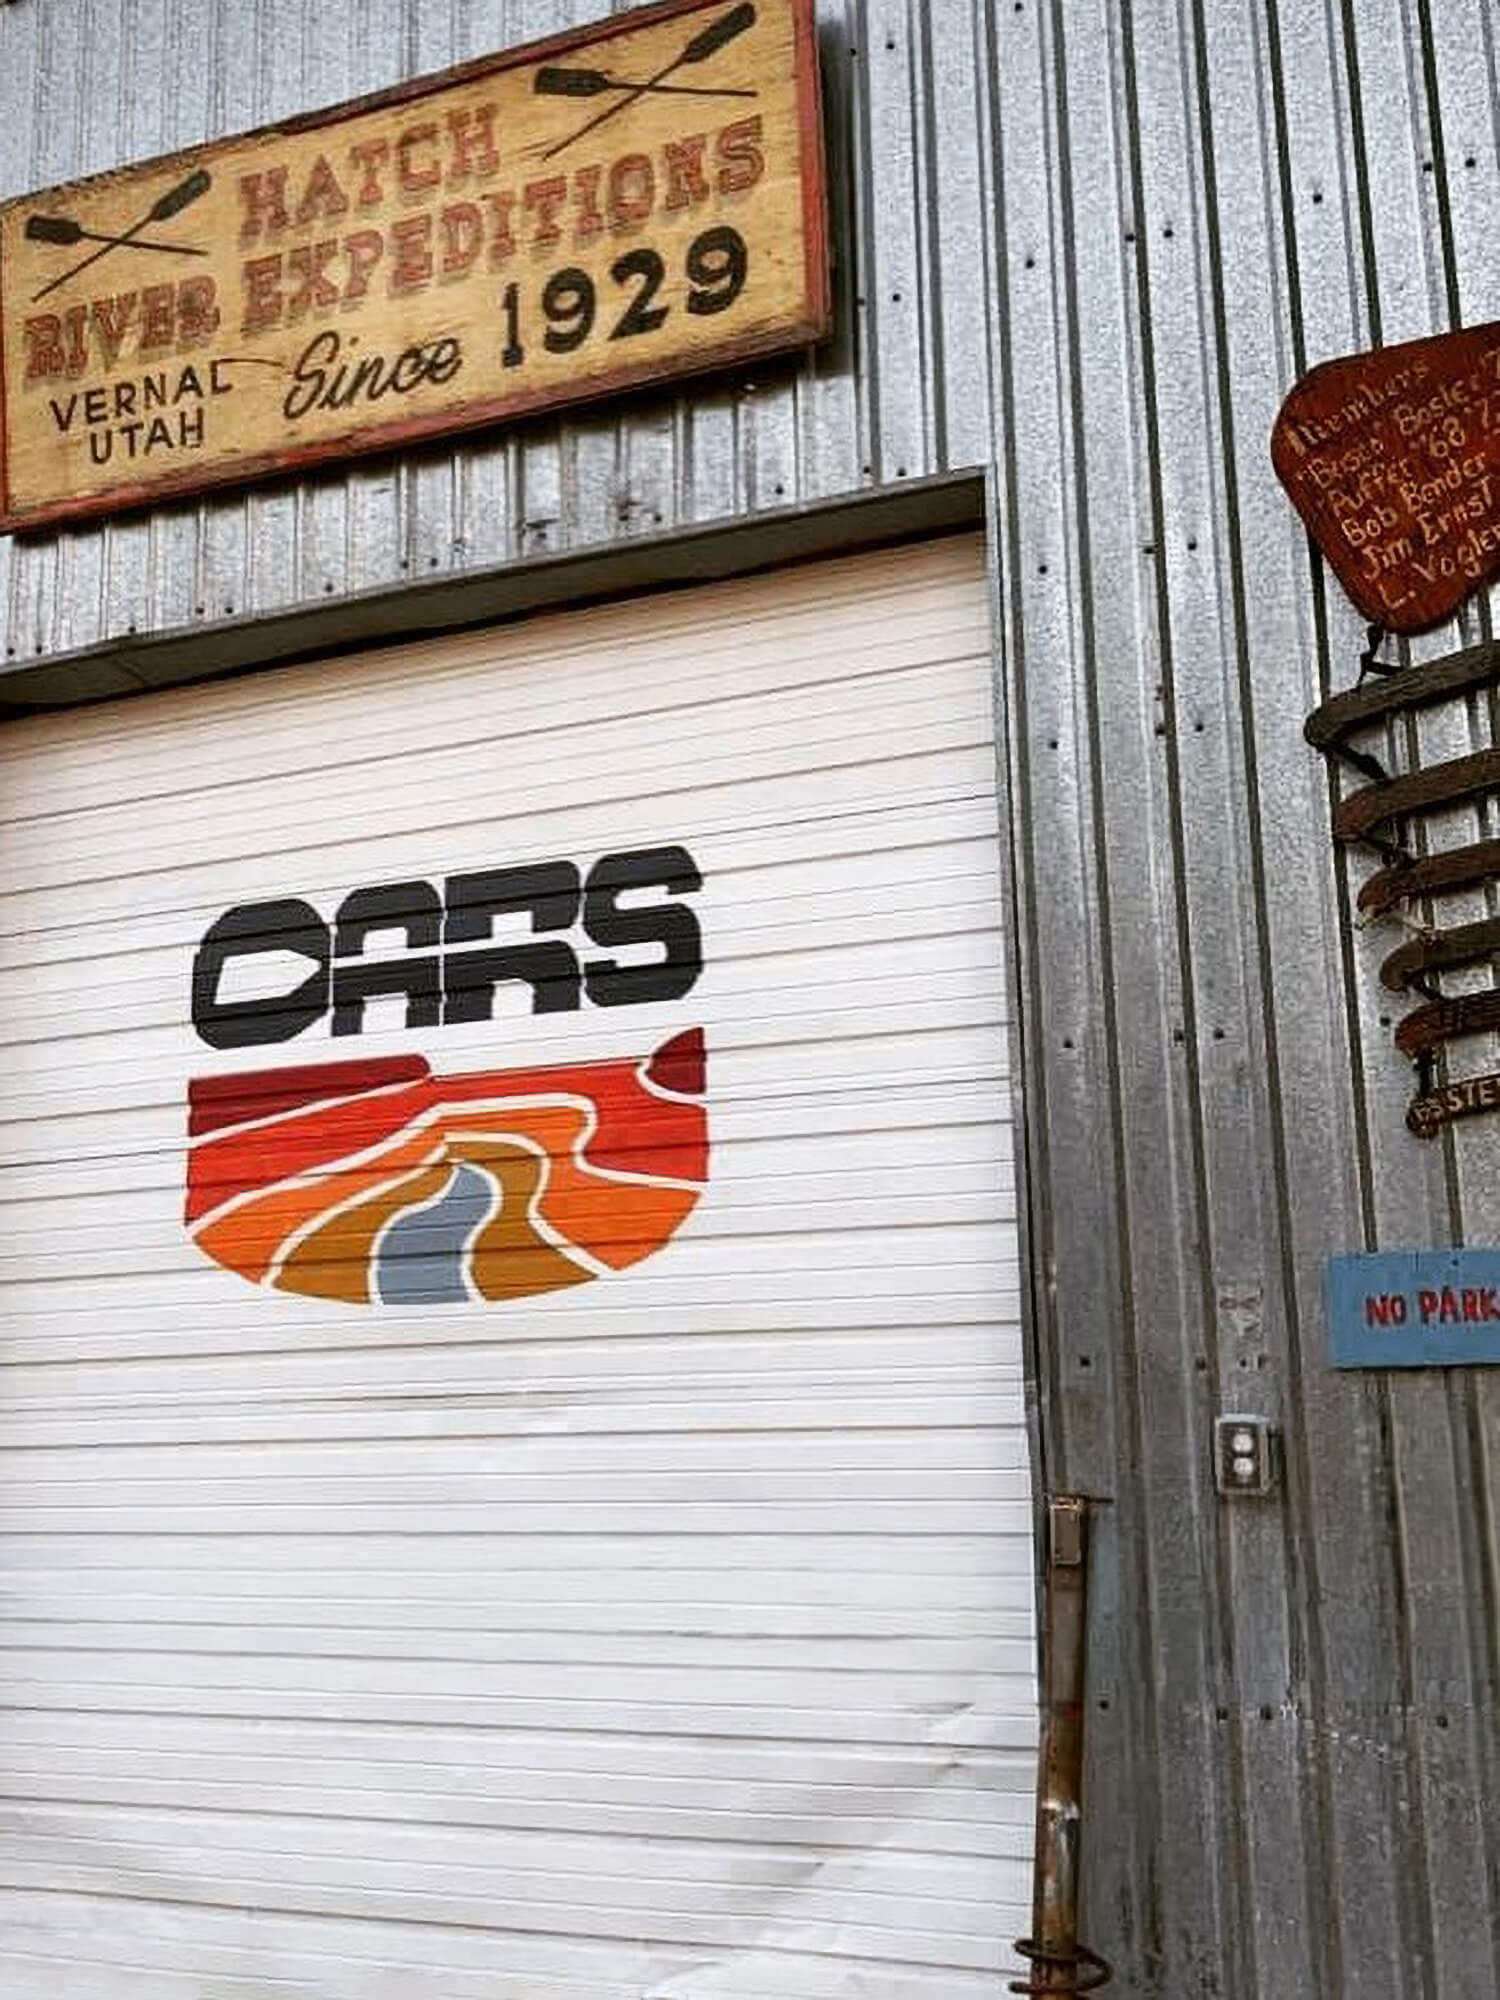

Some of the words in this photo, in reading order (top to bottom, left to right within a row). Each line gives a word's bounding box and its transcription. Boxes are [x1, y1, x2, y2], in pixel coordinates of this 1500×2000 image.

[238, 103, 500, 244] HATCH
[25, 275, 221, 382] RIVER
[243, 114, 765, 332] EXPEDITIONS
[283, 331, 463, 421] Since
[502, 226, 748, 368] 1929
[50, 360, 234, 432] VERNAL
[89, 408, 205, 465] UTAH
[1341, 505, 1397, 547] Bob
[1361, 538, 1413, 580] Jim
[1365, 1293, 1407, 1328] NO
